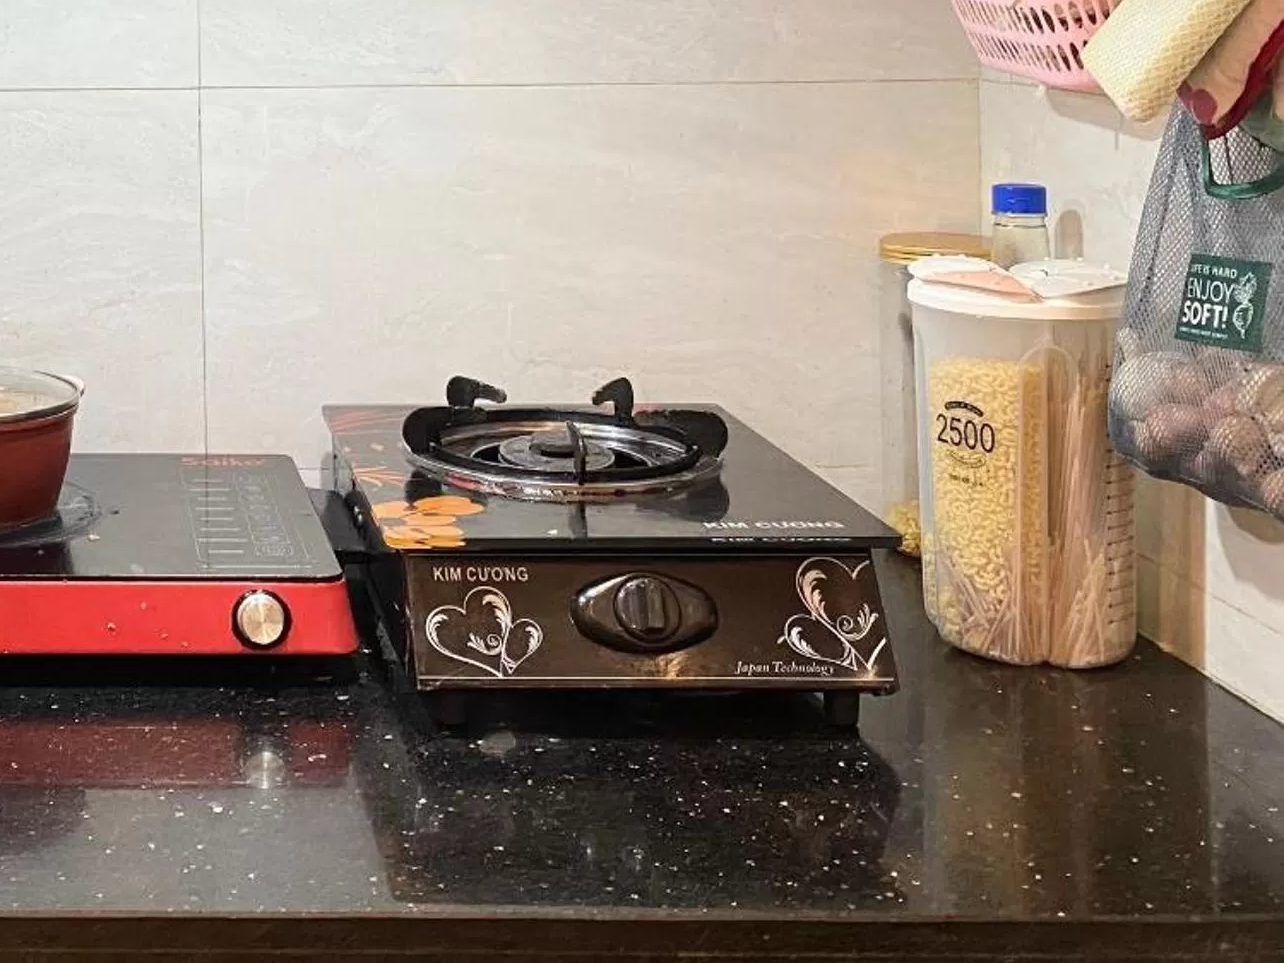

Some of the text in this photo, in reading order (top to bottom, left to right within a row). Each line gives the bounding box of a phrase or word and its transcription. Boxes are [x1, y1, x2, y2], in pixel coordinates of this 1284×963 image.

[1187, 277, 1236, 304] ENJOY
[1182, 299, 1229, 329] SOFT!
[936, 413, 996, 454] 2500
[432, 566, 462, 582] KIM
[734, 660, 834, 677] Japan Technology
